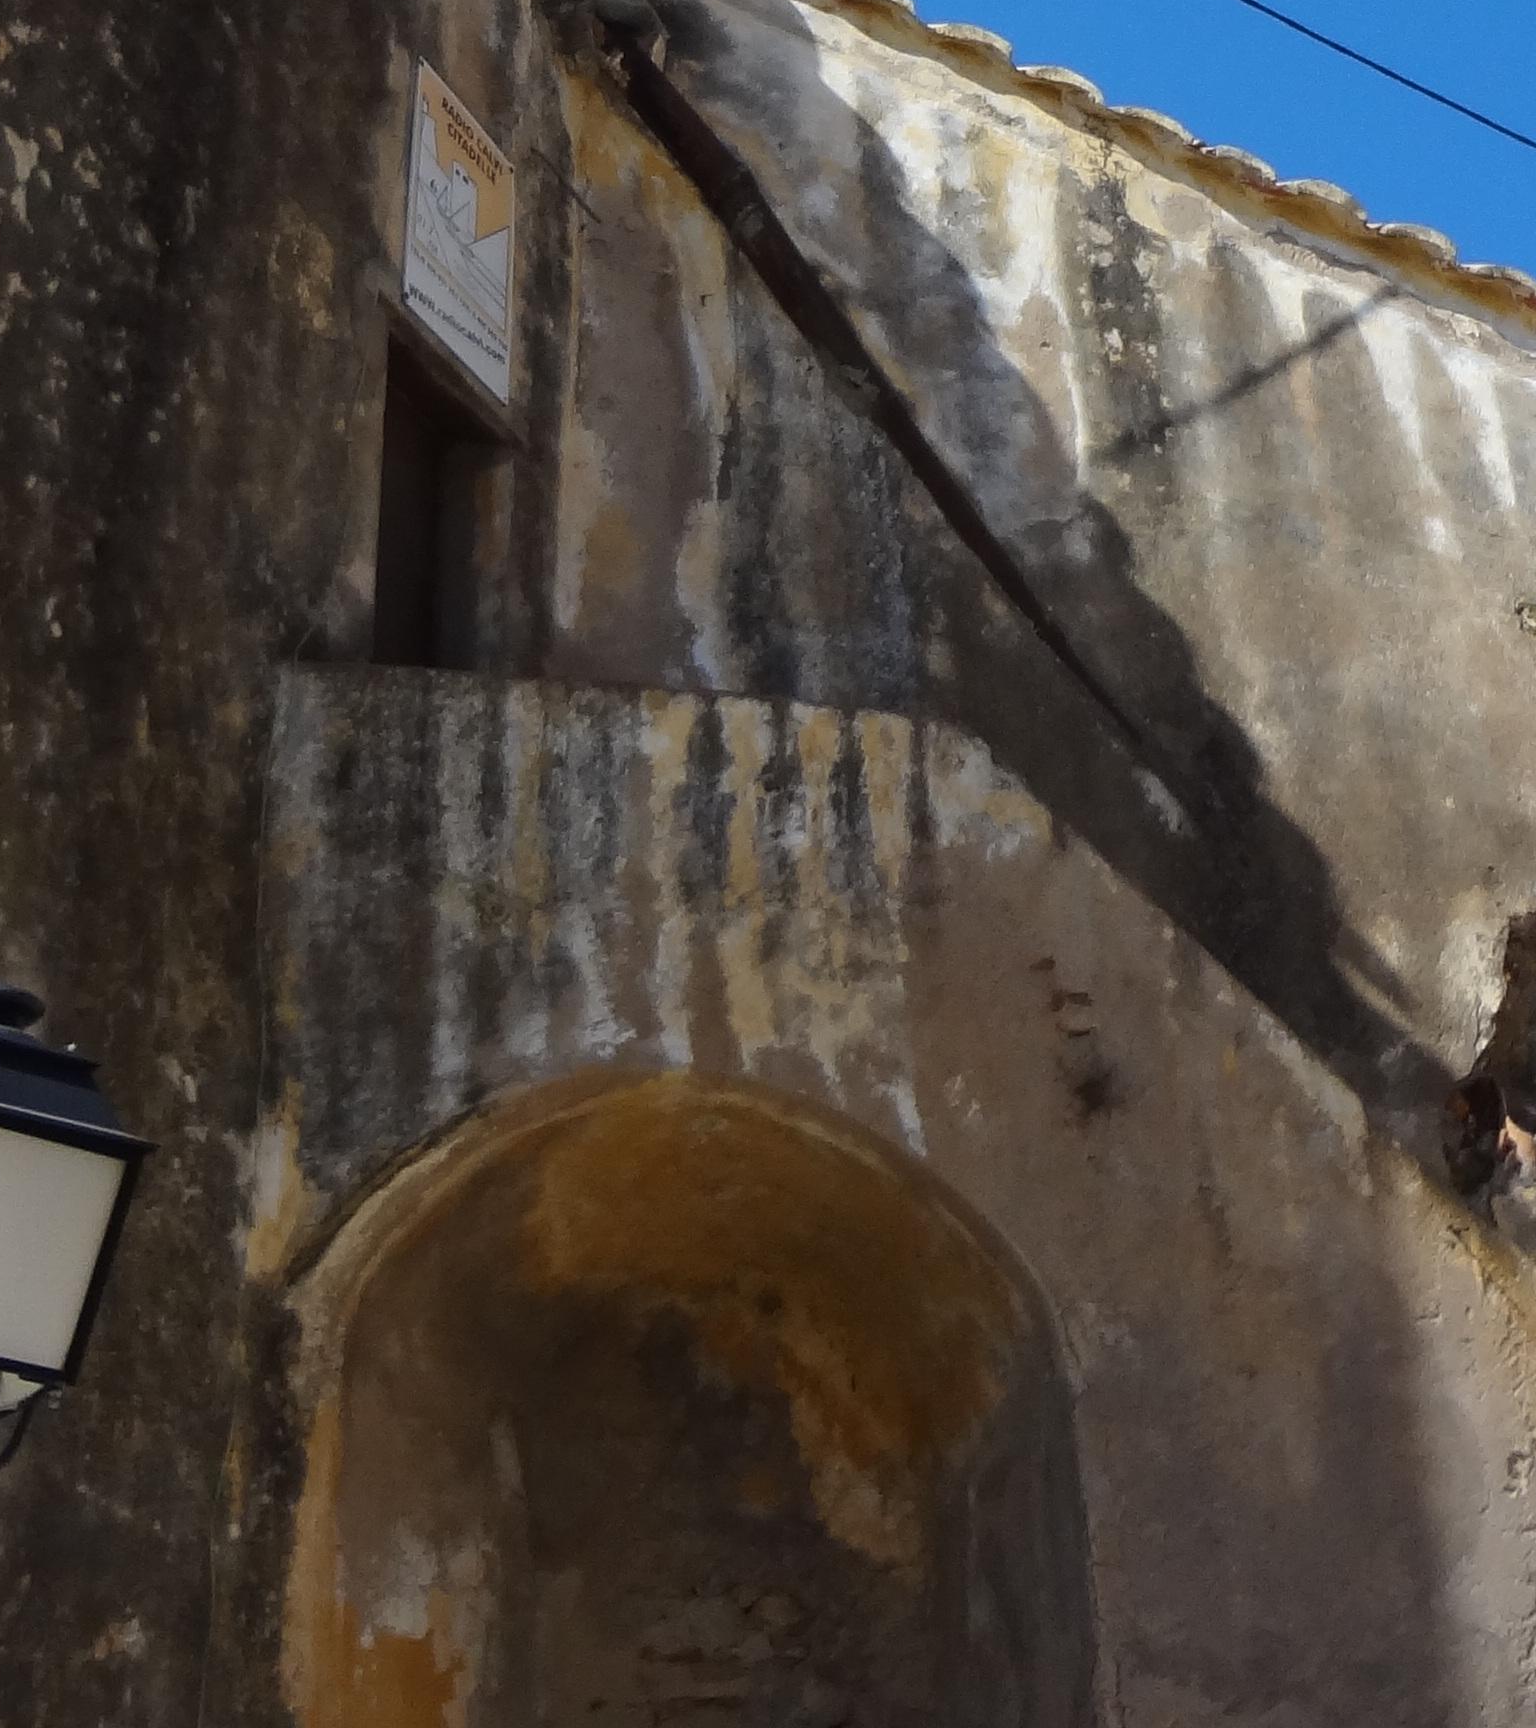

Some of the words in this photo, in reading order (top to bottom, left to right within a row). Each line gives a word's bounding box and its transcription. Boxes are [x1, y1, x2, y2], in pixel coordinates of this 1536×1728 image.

[441, 97, 474, 140] RADIO
[477, 138, 503, 176] CALVI
[447, 122, 496, 186] CITADELLE
